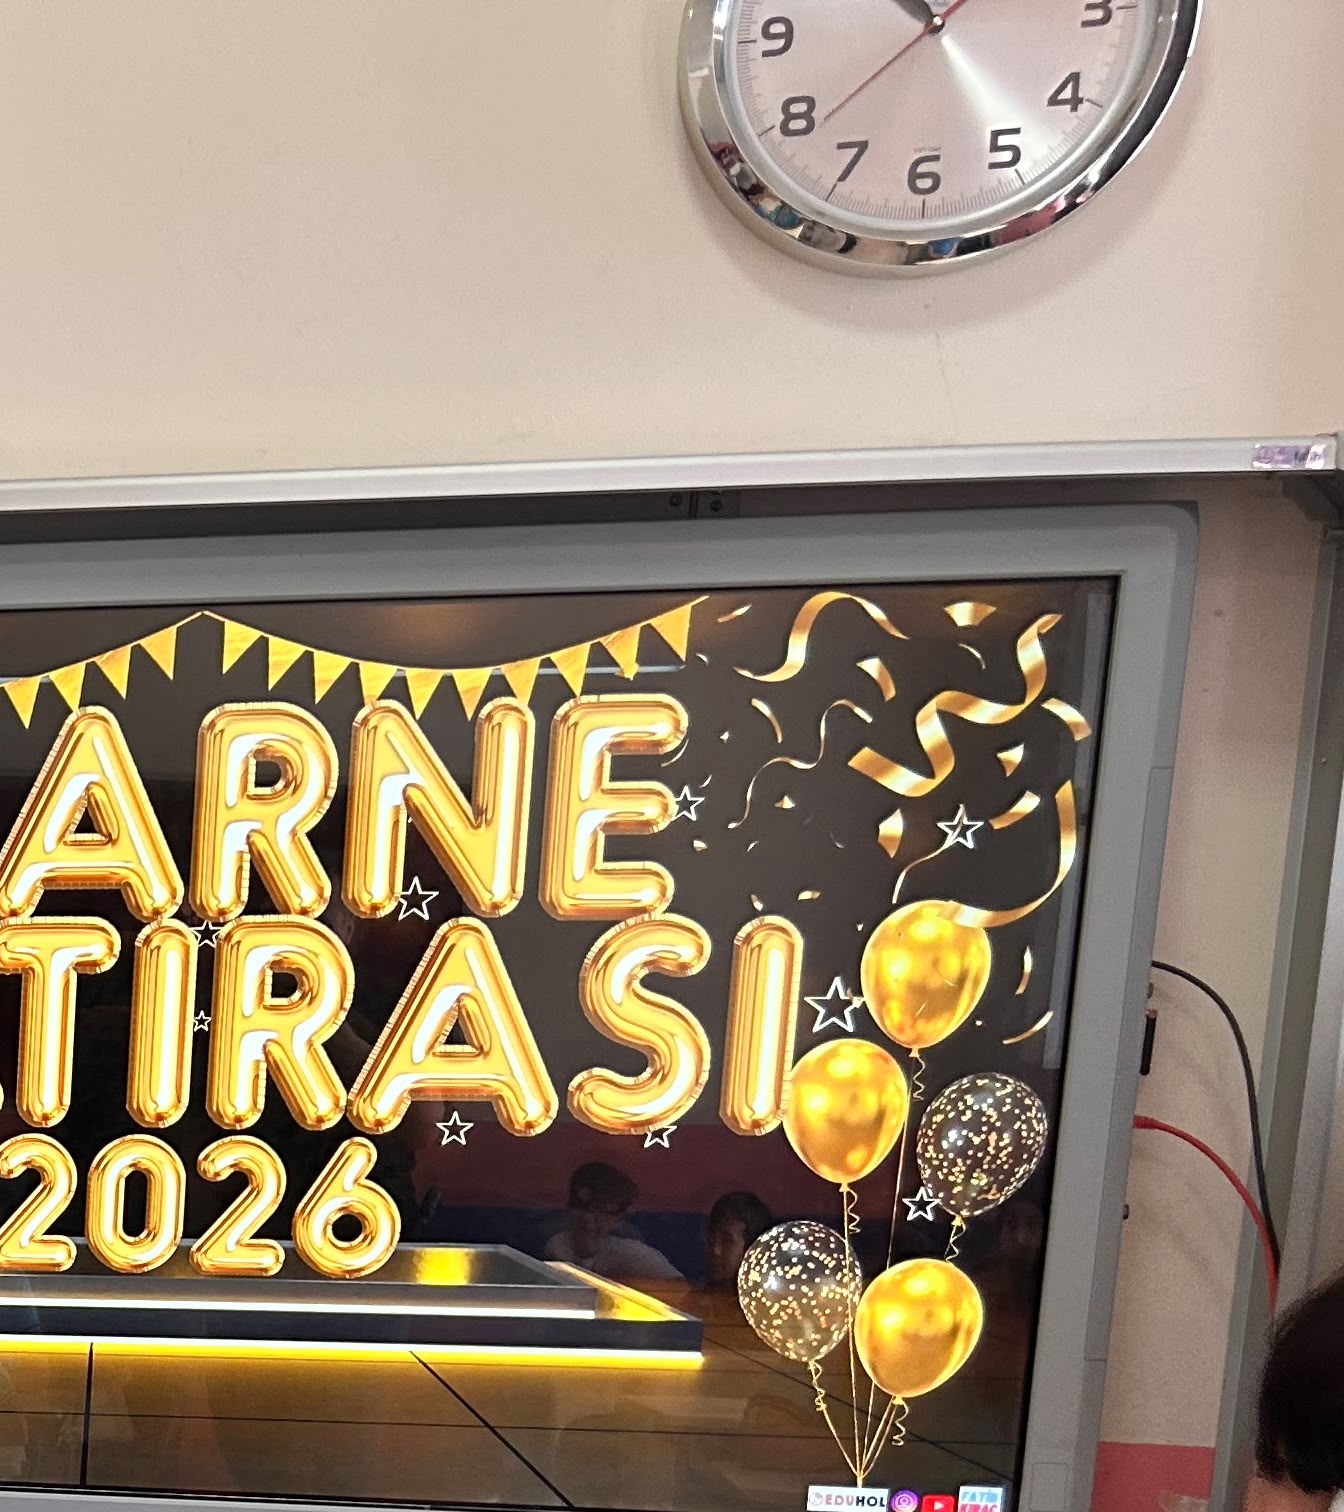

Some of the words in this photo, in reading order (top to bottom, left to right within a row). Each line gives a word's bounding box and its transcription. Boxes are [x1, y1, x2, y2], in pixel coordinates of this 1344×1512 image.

[1081, 0, 1113, 28] 3
[760, 16, 794, 58] 9
[1046, 71, 1084, 113] 4
[779, 95, 816, 137] 8
[836, 139, 869, 182] 7
[988, 127, 1022, 170] 5
[907, 154, 942, 196] 6
